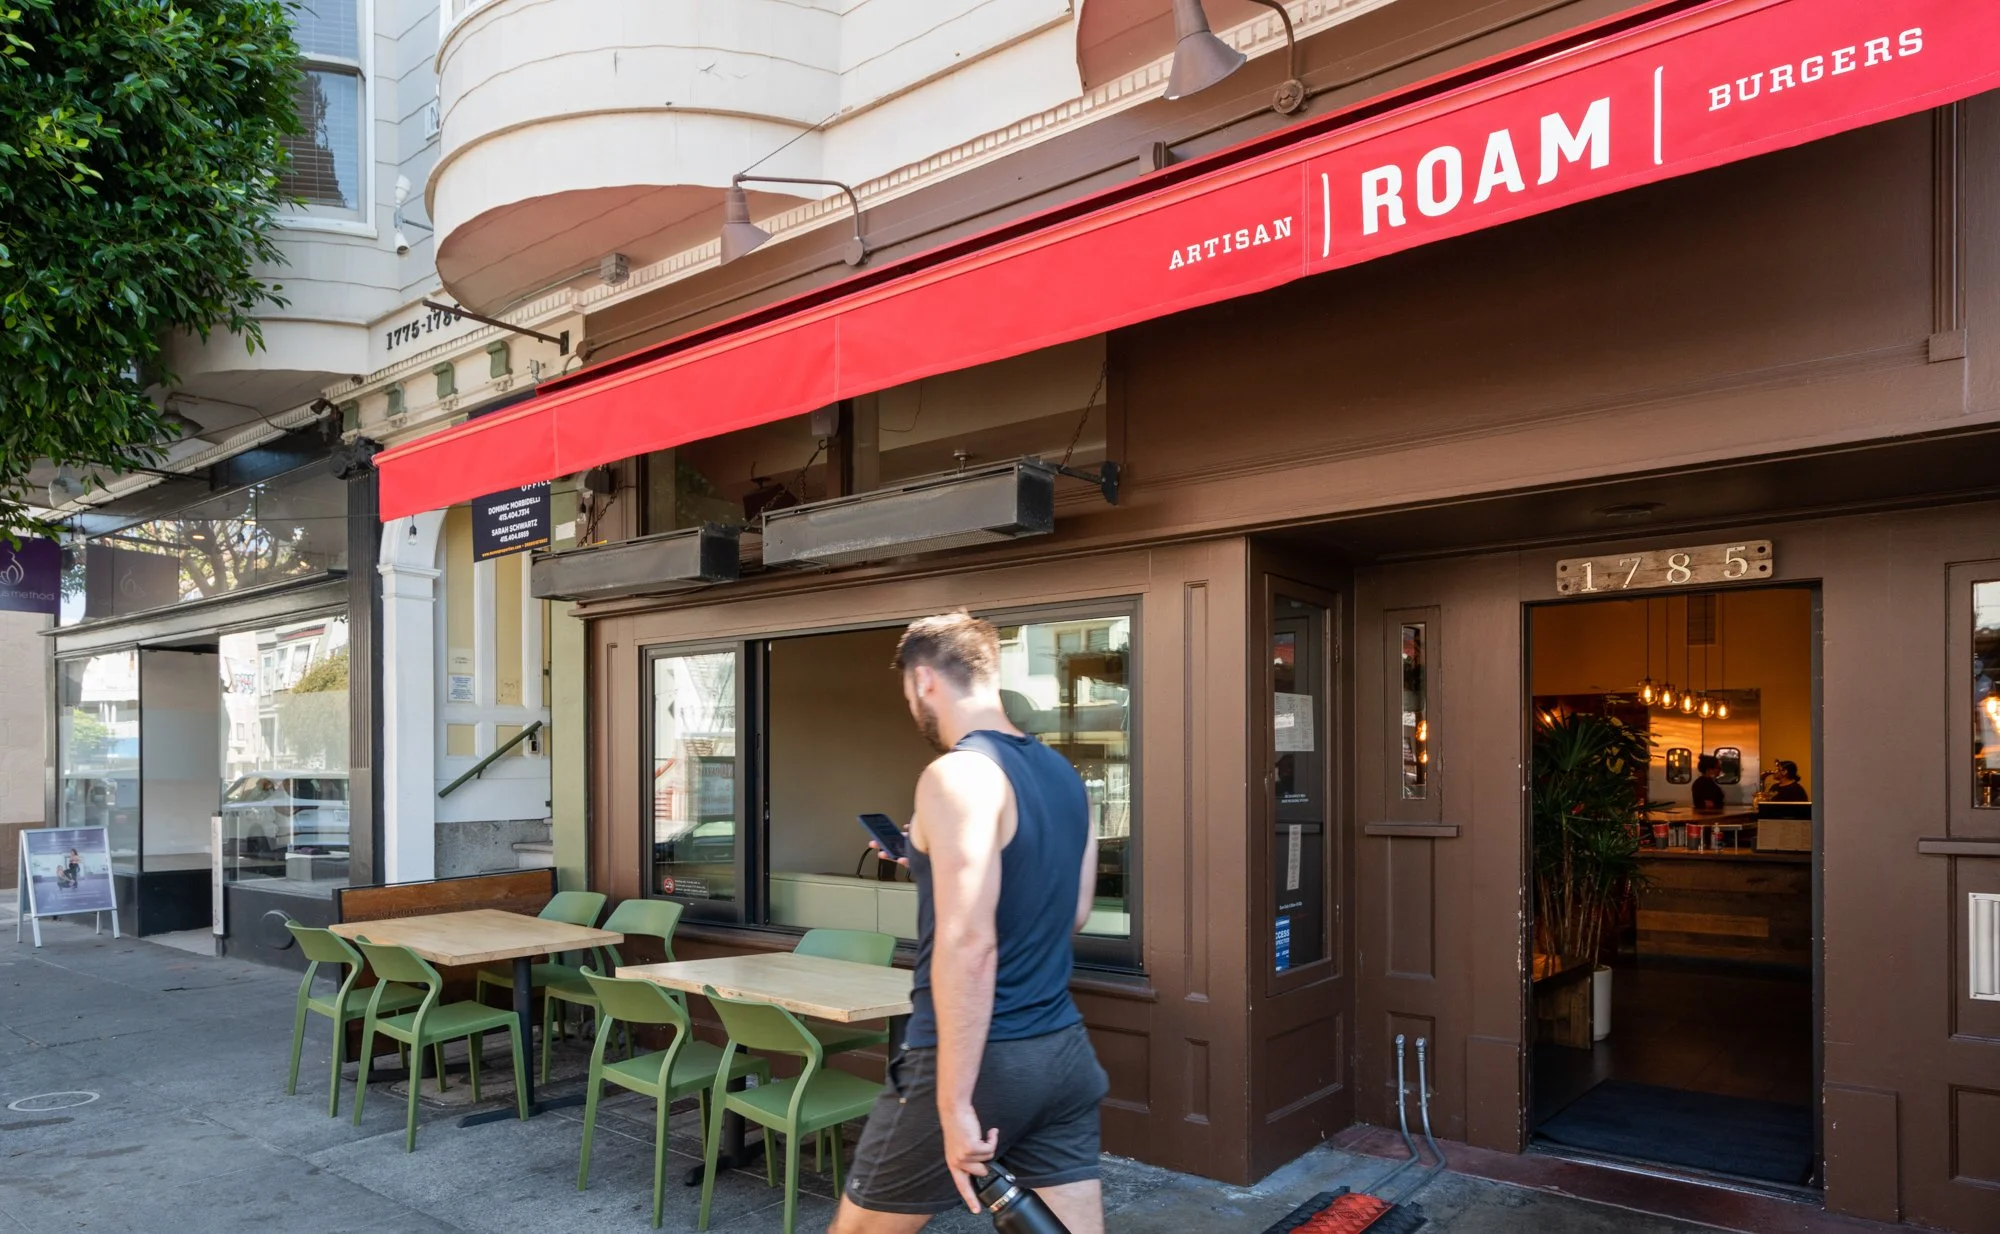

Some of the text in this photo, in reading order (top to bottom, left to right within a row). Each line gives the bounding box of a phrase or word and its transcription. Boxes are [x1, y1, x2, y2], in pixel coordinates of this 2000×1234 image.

[1168, 27, 1924, 271] ARTISAN ROAM BURGERS
[488, 503, 510, 515] DOMINIC
[491, 519, 538, 536] SARAH SCHWARTZ
